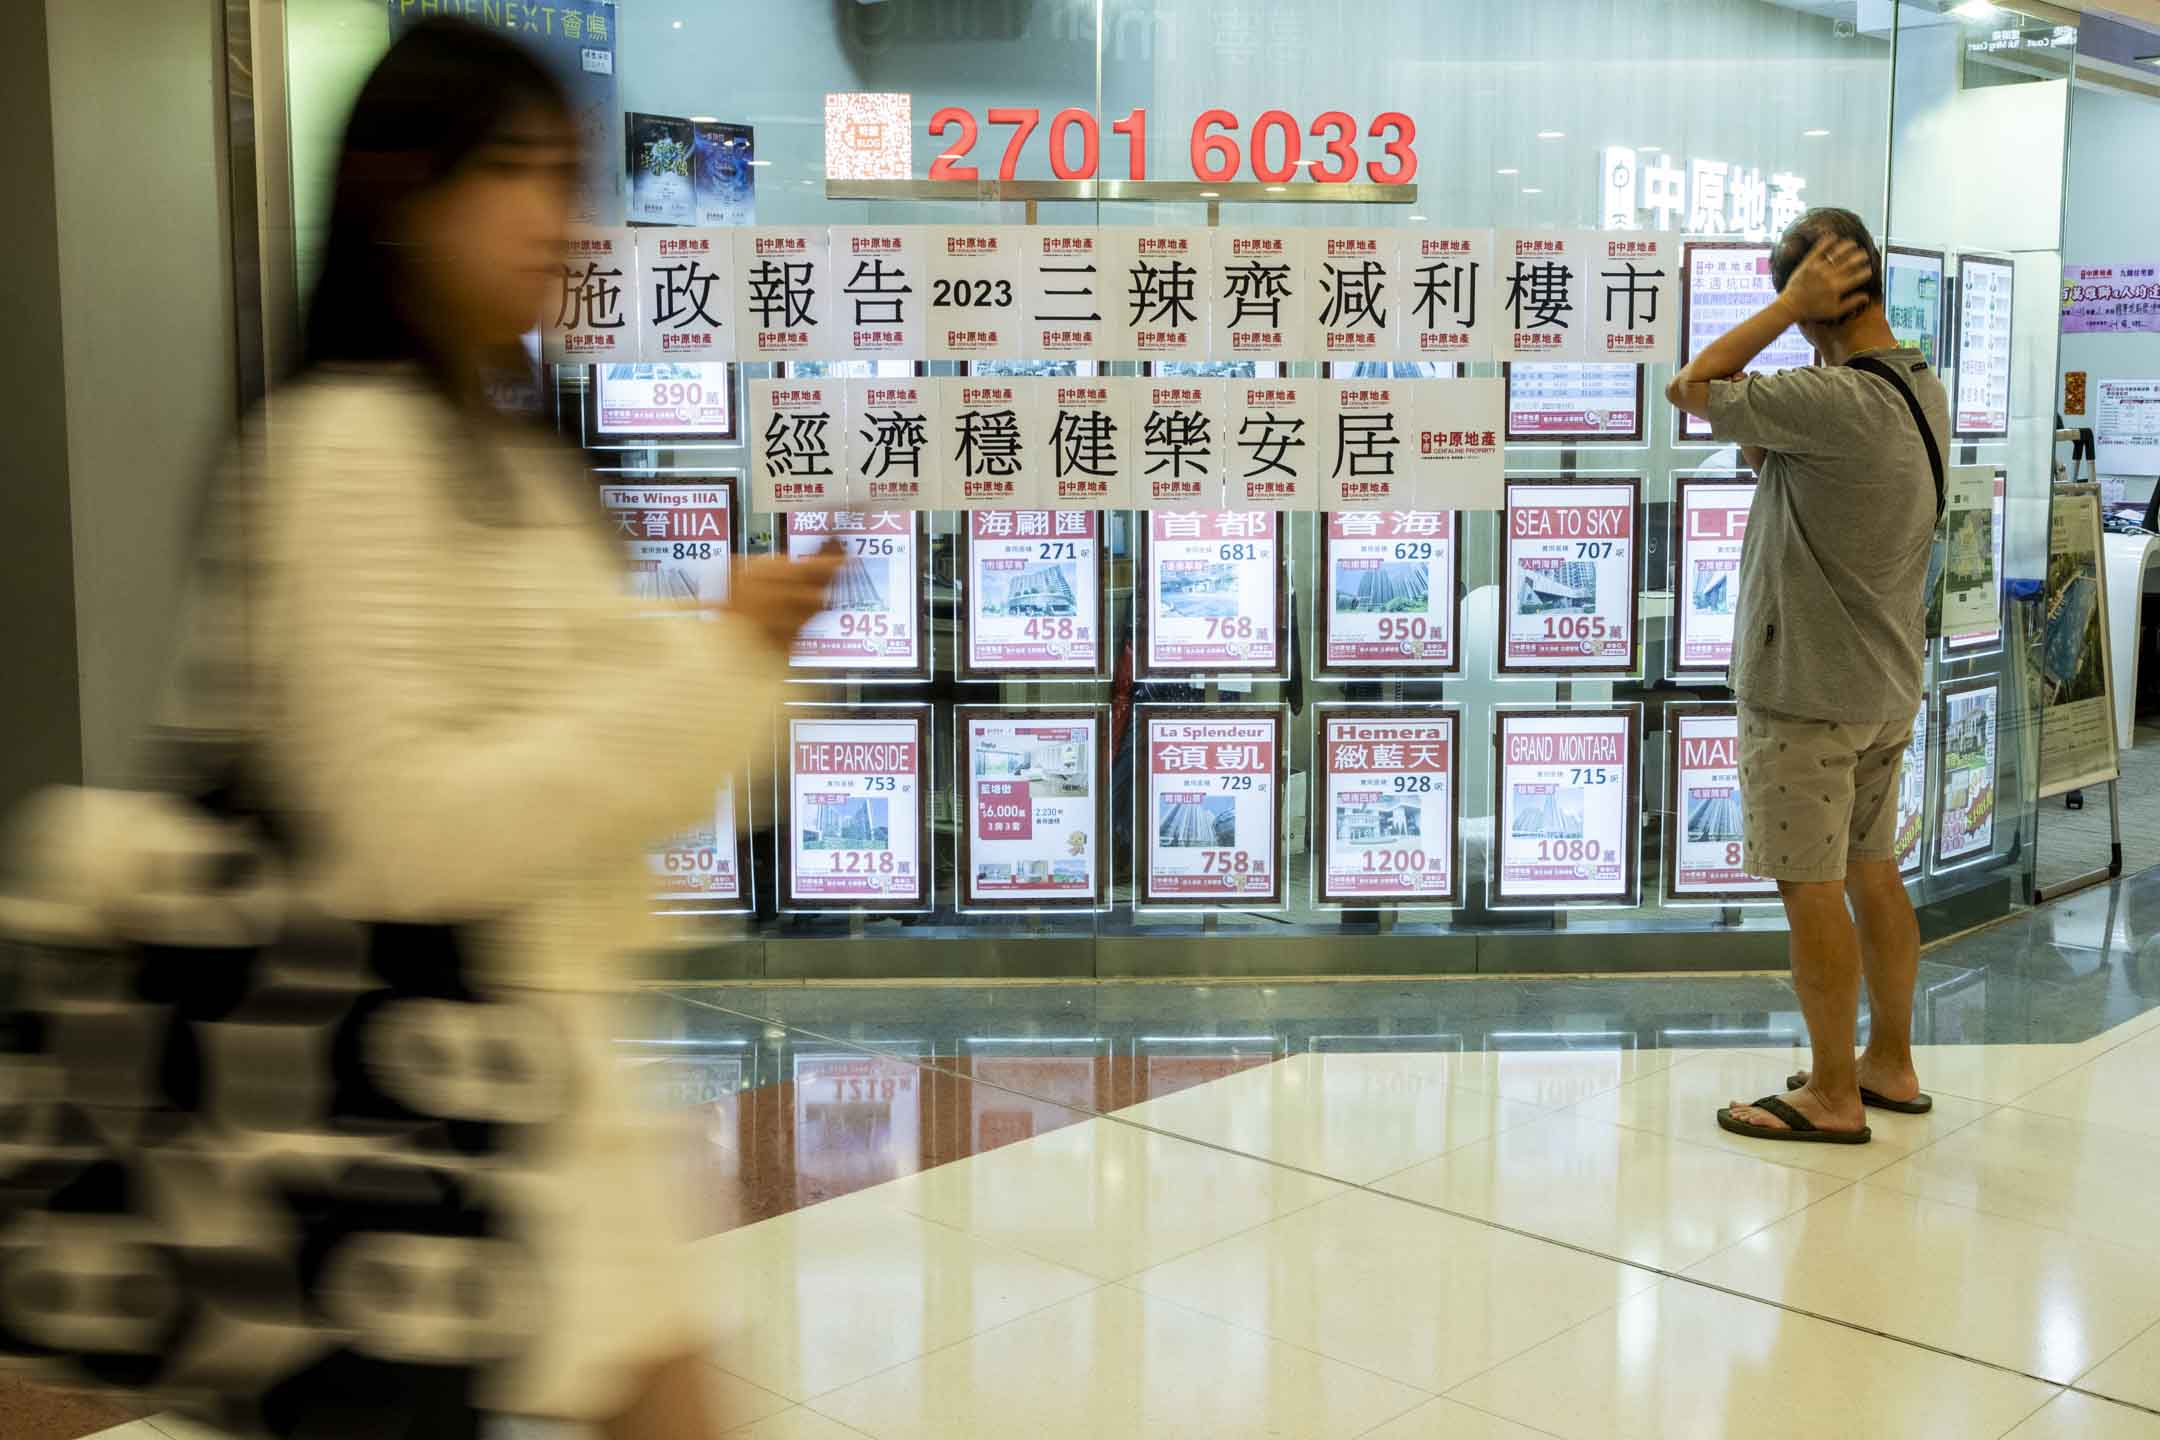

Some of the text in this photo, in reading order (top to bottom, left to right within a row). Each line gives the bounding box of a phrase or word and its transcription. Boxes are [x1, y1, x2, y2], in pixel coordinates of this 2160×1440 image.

[928, 107, 1417, 185] 2701 6033
[1645, 154, 1807, 241] 中原地產
[668, 239, 710, 250] 中原地產
[763, 238, 807, 249] 中原地產
[860, 237, 902, 248] 中原地產
[955, 237, 998, 248] 中原地產
[1051, 237, 1093, 248] 中原地產
[1146, 239, 1188, 250] 中原地產
[1240, 239, 1282, 250] 中原地產
[1335, 240, 1377, 250] 中原地產
[1429, 240, 1471, 250] 中原地產
[1523, 240, 1565, 251] 中原地產
[1616, 241, 1657, 252] 中原地產
[554, 259, 1665, 330] 施政報告2023三辣齊減利樓市
[573, 334, 615, 345] 中原地產
[670, 334, 712, 344] 中原地產
[766, 332, 809, 343] 中原地產
[861, 332, 904, 342] 中原地產
[956, 332, 997, 342] 中原地產
[1051, 332, 1093, 342] 中原地產
[1145, 332, 1187, 343] 中原地產
[1240, 333, 1282, 343] 中原地產
[1335, 333, 1376, 343] 中原地產
[1428, 334, 1470, 344] 中原地產
[1522, 334, 1562, 344] 中原地產
[1615, 334, 1655, 344] 中原地產
[653, 383, 702, 405] 890
[780, 390, 822, 401] 中原地產
[875, 390, 918, 400] 中原地產
[971, 388, 1013, 399] 中原地產
[1066, 389, 1108, 400] 中原地產
[1160, 390, 1202, 400] 中原地產
[1254, 390, 1296, 400] 中原地產
[1349, 390, 1391, 401] 中原地產
[1433, 431, 1496, 446] 中原地產
[764, 410, 1401, 479] 經濟穩健樂安居
[783, 483, 825, 494] 中原地產
[878, 482, 920, 493] 中原地產
[972, 482, 1014, 492] 中原地產
[1066, 482, 1108, 492] 中原地產
[1160, 482, 1201, 492] 中原地產
[1254, 482, 1296, 493] 中原地產
[1349, 482, 1390, 493] 中原地產
[612, 492, 639, 503] The
[643, 492, 689, 506] Wings
[1158, 511, 1267, 537] 首都
[1515, 508, 1624, 536] SEA TO SKY
[672, 543, 711, 560] 848
[855, 538, 893, 555] 756
[1039, 543, 1077, 560] 271
[1219, 543, 1257, 560] 681
[1394, 543, 1432, 560] 629
[1575, 542, 1613, 559] 707
[840, 614, 888, 637] 945
[1023, 618, 1073, 640] 458
[1205, 617, 1253, 639] 768
[1378, 617, 1427, 640] 950
[1543, 616, 1606, 639] 1065
[1160, 726, 1265, 740] La Splendeur
[1336, 726, 1441, 740] Hemera
[1511, 735, 1617, 762] GRAND MONTARA
[800, 744, 909, 771] THE PARKSIDE
[1158, 744, 1265, 770] 領凱
[1335, 744, 1441, 769] 緻藍天
[1570, 768, 1607, 785] 715
[864, 776, 896, 791] 753
[1220, 776, 1252, 791] 729
[1394, 776, 1431, 792] 928
[1537, 839, 1601, 861] 1080
[664, 848, 713, 871] 650
[830, 851, 894, 873] 1218
[1201, 850, 1249, 873] 758
[1361, 850, 1426, 872] 1200
